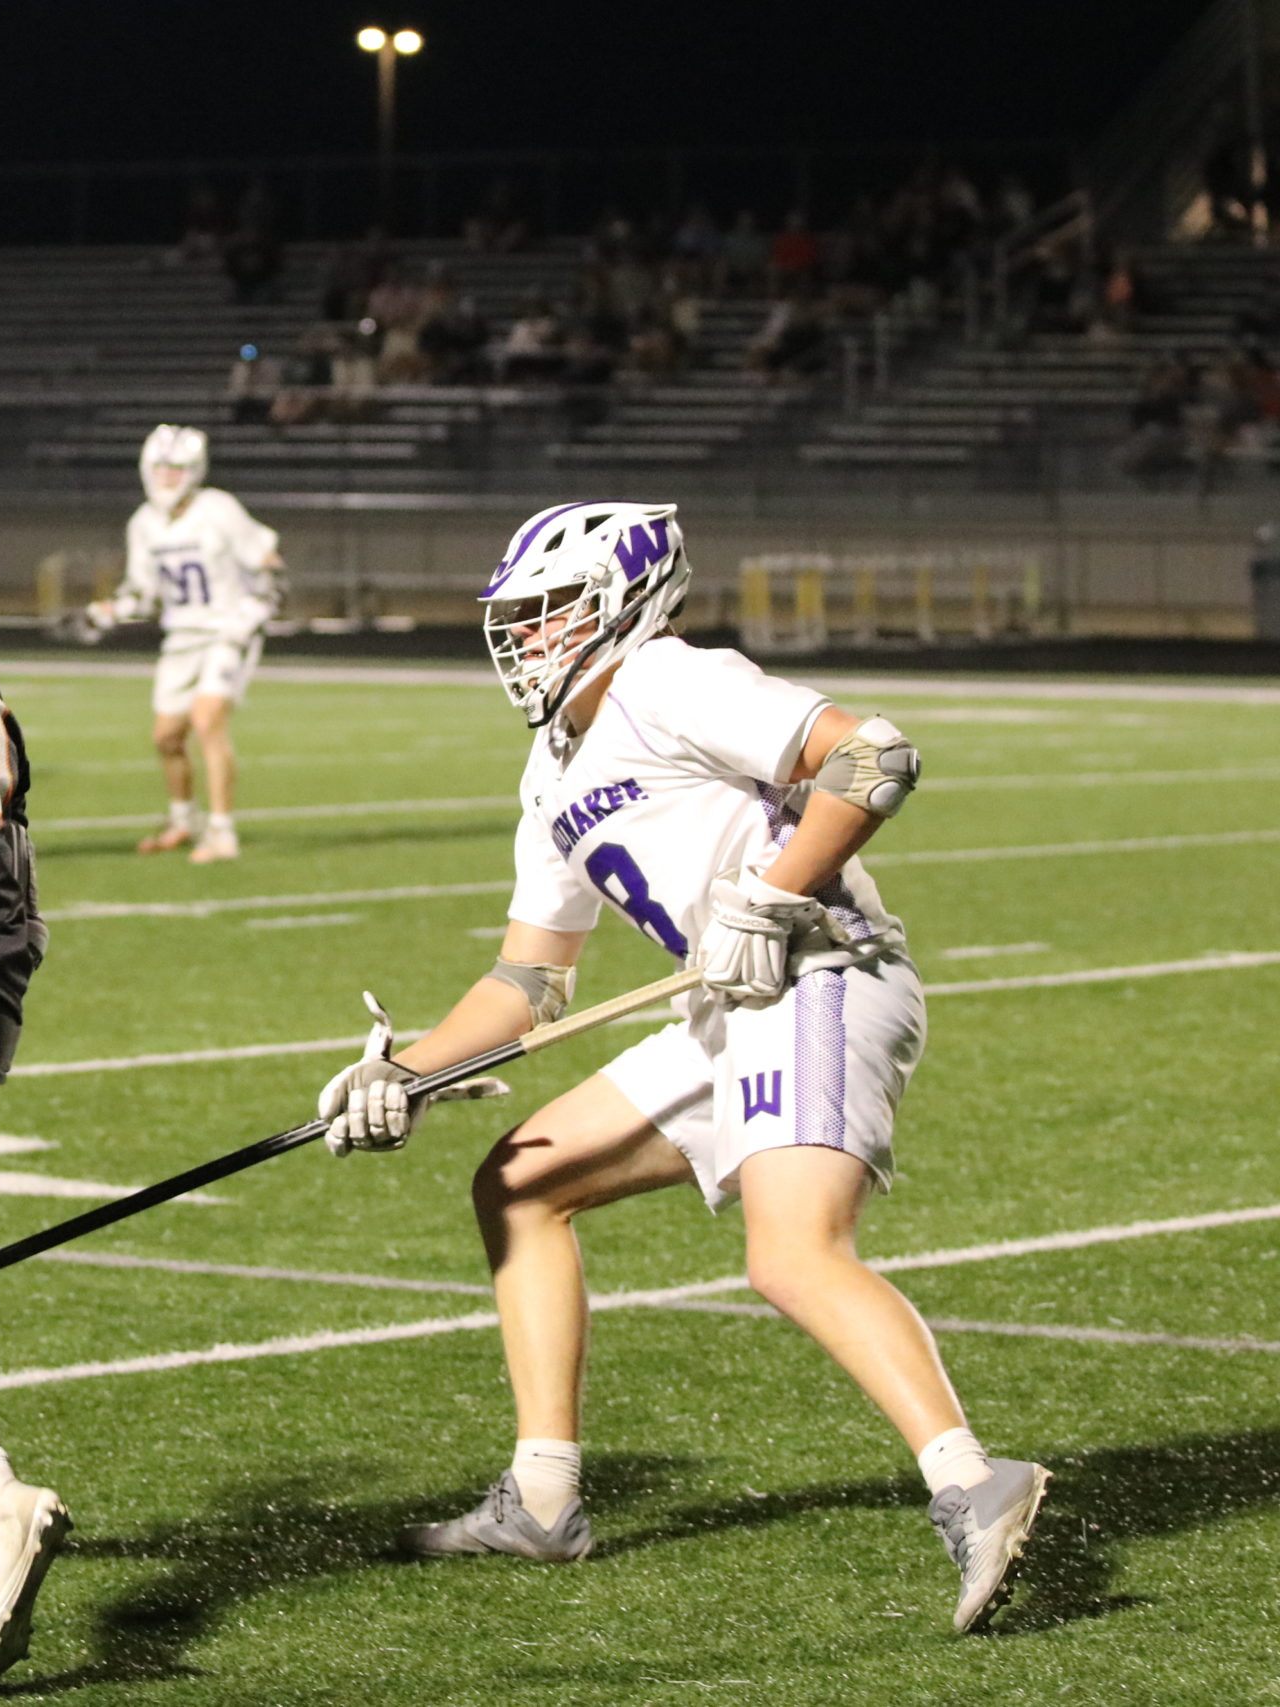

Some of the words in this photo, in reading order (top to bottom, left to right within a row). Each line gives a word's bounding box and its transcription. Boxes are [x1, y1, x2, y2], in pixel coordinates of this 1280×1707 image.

[601, 518, 670, 582] W
[551, 778, 649, 864] UNAKEE
[584, 842, 689, 961] 8
[738, 1070, 783, 1125] W
